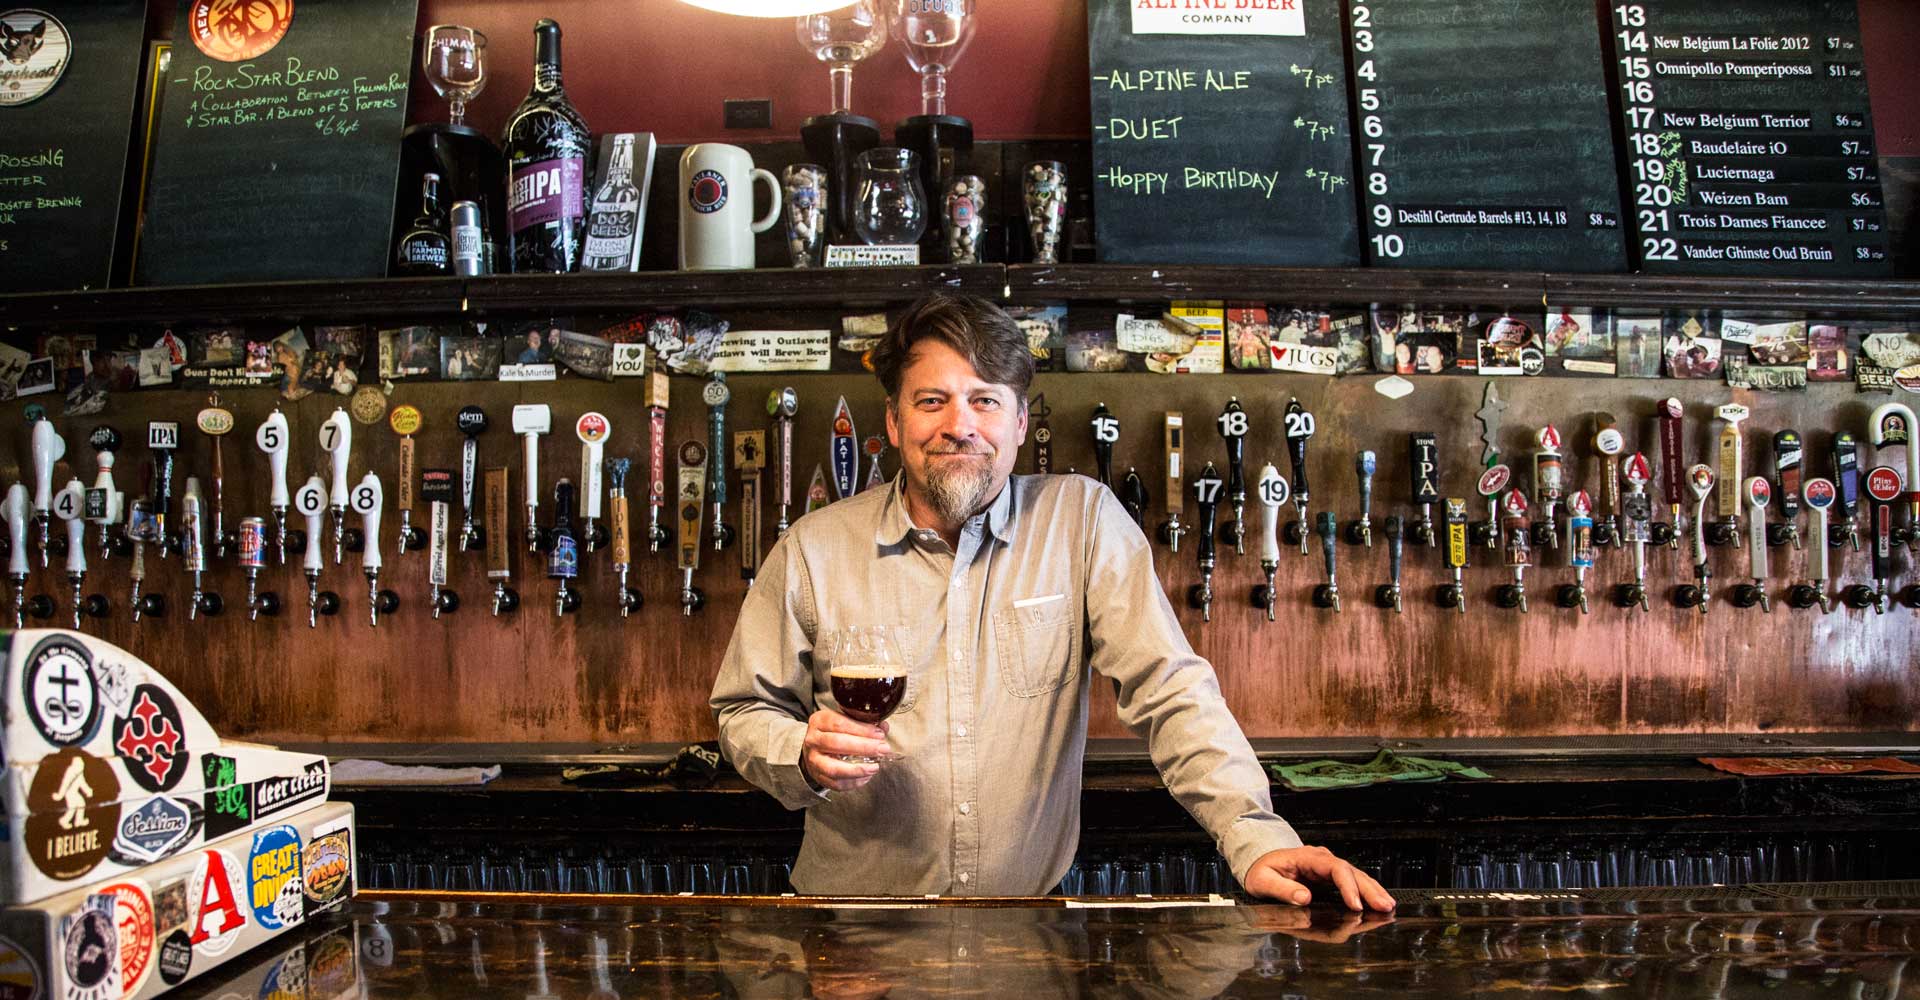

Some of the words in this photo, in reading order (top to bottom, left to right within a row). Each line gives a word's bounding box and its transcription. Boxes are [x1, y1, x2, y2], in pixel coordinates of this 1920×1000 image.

[198, 5, 212, 40] NEW
[1182, 14, 1253, 24] COMPANY
[1352, 6, 1371, 28] 2
[1615, 5, 1645, 27] 13
[1355, 30, 1374, 52] 3
[1618, 30, 1648, 52] 14
[1653, 36, 1679, 50] New
[1682, 36, 1730, 53] Belgium
[1732, 37, 1748, 50] La
[1750, 36, 1780, 51] Folie
[1781, 37, 1810, 51] 2012
[1827, 37, 1840, 49] $7
[285, 57, 339, 86] BLEND
[1357, 60, 1377, 82] 4
[1620, 57, 1650, 79] 15
[1655, 62, 1723, 77] Omnipollo
[1725, 64, 1812, 79] Pomperipossa
[1829, 64, 1846, 77] $11
[1205, 69, 1251, 92] ALE
[1623, 81, 1654, 103] 16
[201, 94, 288, 111] COLLABORATION
[297, 88, 350, 101] BETWEEN
[1361, 89, 1380, 111] 5
[198, 113, 231, 127] STAR
[266, 108, 274, 120] A
[278, 106, 315, 119] BLEND
[319, 103, 335, 113] OF
[339, 97, 348, 112] 5
[1626, 107, 1655, 129] 17
[1663, 113, 1696, 128] New
[1700, 113, 1758, 130] Belgium
[1761, 114, 1810, 128] Terrior
[1836, 114, 1849, 127] $6
[1364, 115, 1384, 138] 6
[1367, 144, 1385, 167] 7
[1629, 133, 1660, 155] 18
[1691, 141, 1767, 155] Baudelaire
[1770, 141, 1787, 155] iO
[1841, 141, 1859, 155] $7
[1633, 159, 1664, 182] 19
[1696, 166, 1775, 181] Luciernaga
[1847, 167, 1864, 181] $7
[529, 168, 561, 200] IPA
[1368, 172, 1388, 195] 8
[37, 196, 82, 209] BREWING
[1636, 184, 1672, 207] 20
[1700, 191, 1754, 206] Weizen
[1755, 192, 1789, 206] Bam
[1851, 192, 1870, 206] $6
[598, 213, 629, 225] DOG
[1373, 204, 1392, 228] 9
[1398, 209, 1433, 224] Destihl
[1434, 210, 1477, 224] Gertrude
[1479, 210, 1513, 225] Barrels
[1537, 211, 1553, 226] 14,
[1554, 211, 1567, 225] 18
[1589, 213, 1603, 226] $8
[1639, 210, 1669, 232] 21
[1678, 214, 1717, 229] Trois
[1720, 215, 1768, 229] Dames
[1772, 216, 1826, 229] Fiancee
[1852, 219, 1865, 231] $7
[592, 223, 631, 236] BEERS
[1371, 234, 1403, 258] 10
[1643, 238, 1679, 261] 22
[1683, 245, 1723, 260] Vander
[1726, 246, 1770, 260] Ghinste
[1773, 247, 1797, 260] Oud
[1799, 246, 1832, 260] Bruin
[1856, 247, 1870, 259] $8
[762, 337, 771, 345] is
[777, 336, 829, 345] Outlawed
[1876, 336, 1900, 352] NO
[751, 349, 770, 357] will
[775, 348, 802, 357] Brew
[806, 348, 829, 356] Beer
[1288, 348, 1335, 367] JUGS
[525, 368, 556, 377] Murder
[615, 361, 642, 371] YOU
[1859, 374, 1894, 386] BEER
[459, 412, 484, 421] stem
[1218, 412, 1248, 436] 18
[1285, 413, 1315, 437] 20
[150, 429, 176, 444] IPA
[264, 426, 279, 448] 5
[325, 426, 337, 449] 7
[1092, 417, 1119, 442] 15
[840, 438, 848, 459] FAT
[840, 461, 848, 490] TIRE
[1420, 446, 1437, 495] IPA
[304, 489, 318, 510] 6
[358, 487, 374, 510] 8
[1193, 479, 1223, 502] 17
[1260, 480, 1286, 502] 19
[59, 493, 73, 514] 4
[1453, 527, 1462, 543] IPA
[257, 781, 290, 806] deer
[124, 810, 185, 838] Session
[47, 838, 53, 860] I
[55, 829, 102, 859] BELIEVE.
[252, 842, 298, 882] GREAT
[191, 848, 246, 946] A
[123, 936, 151, 986] ALIKE
